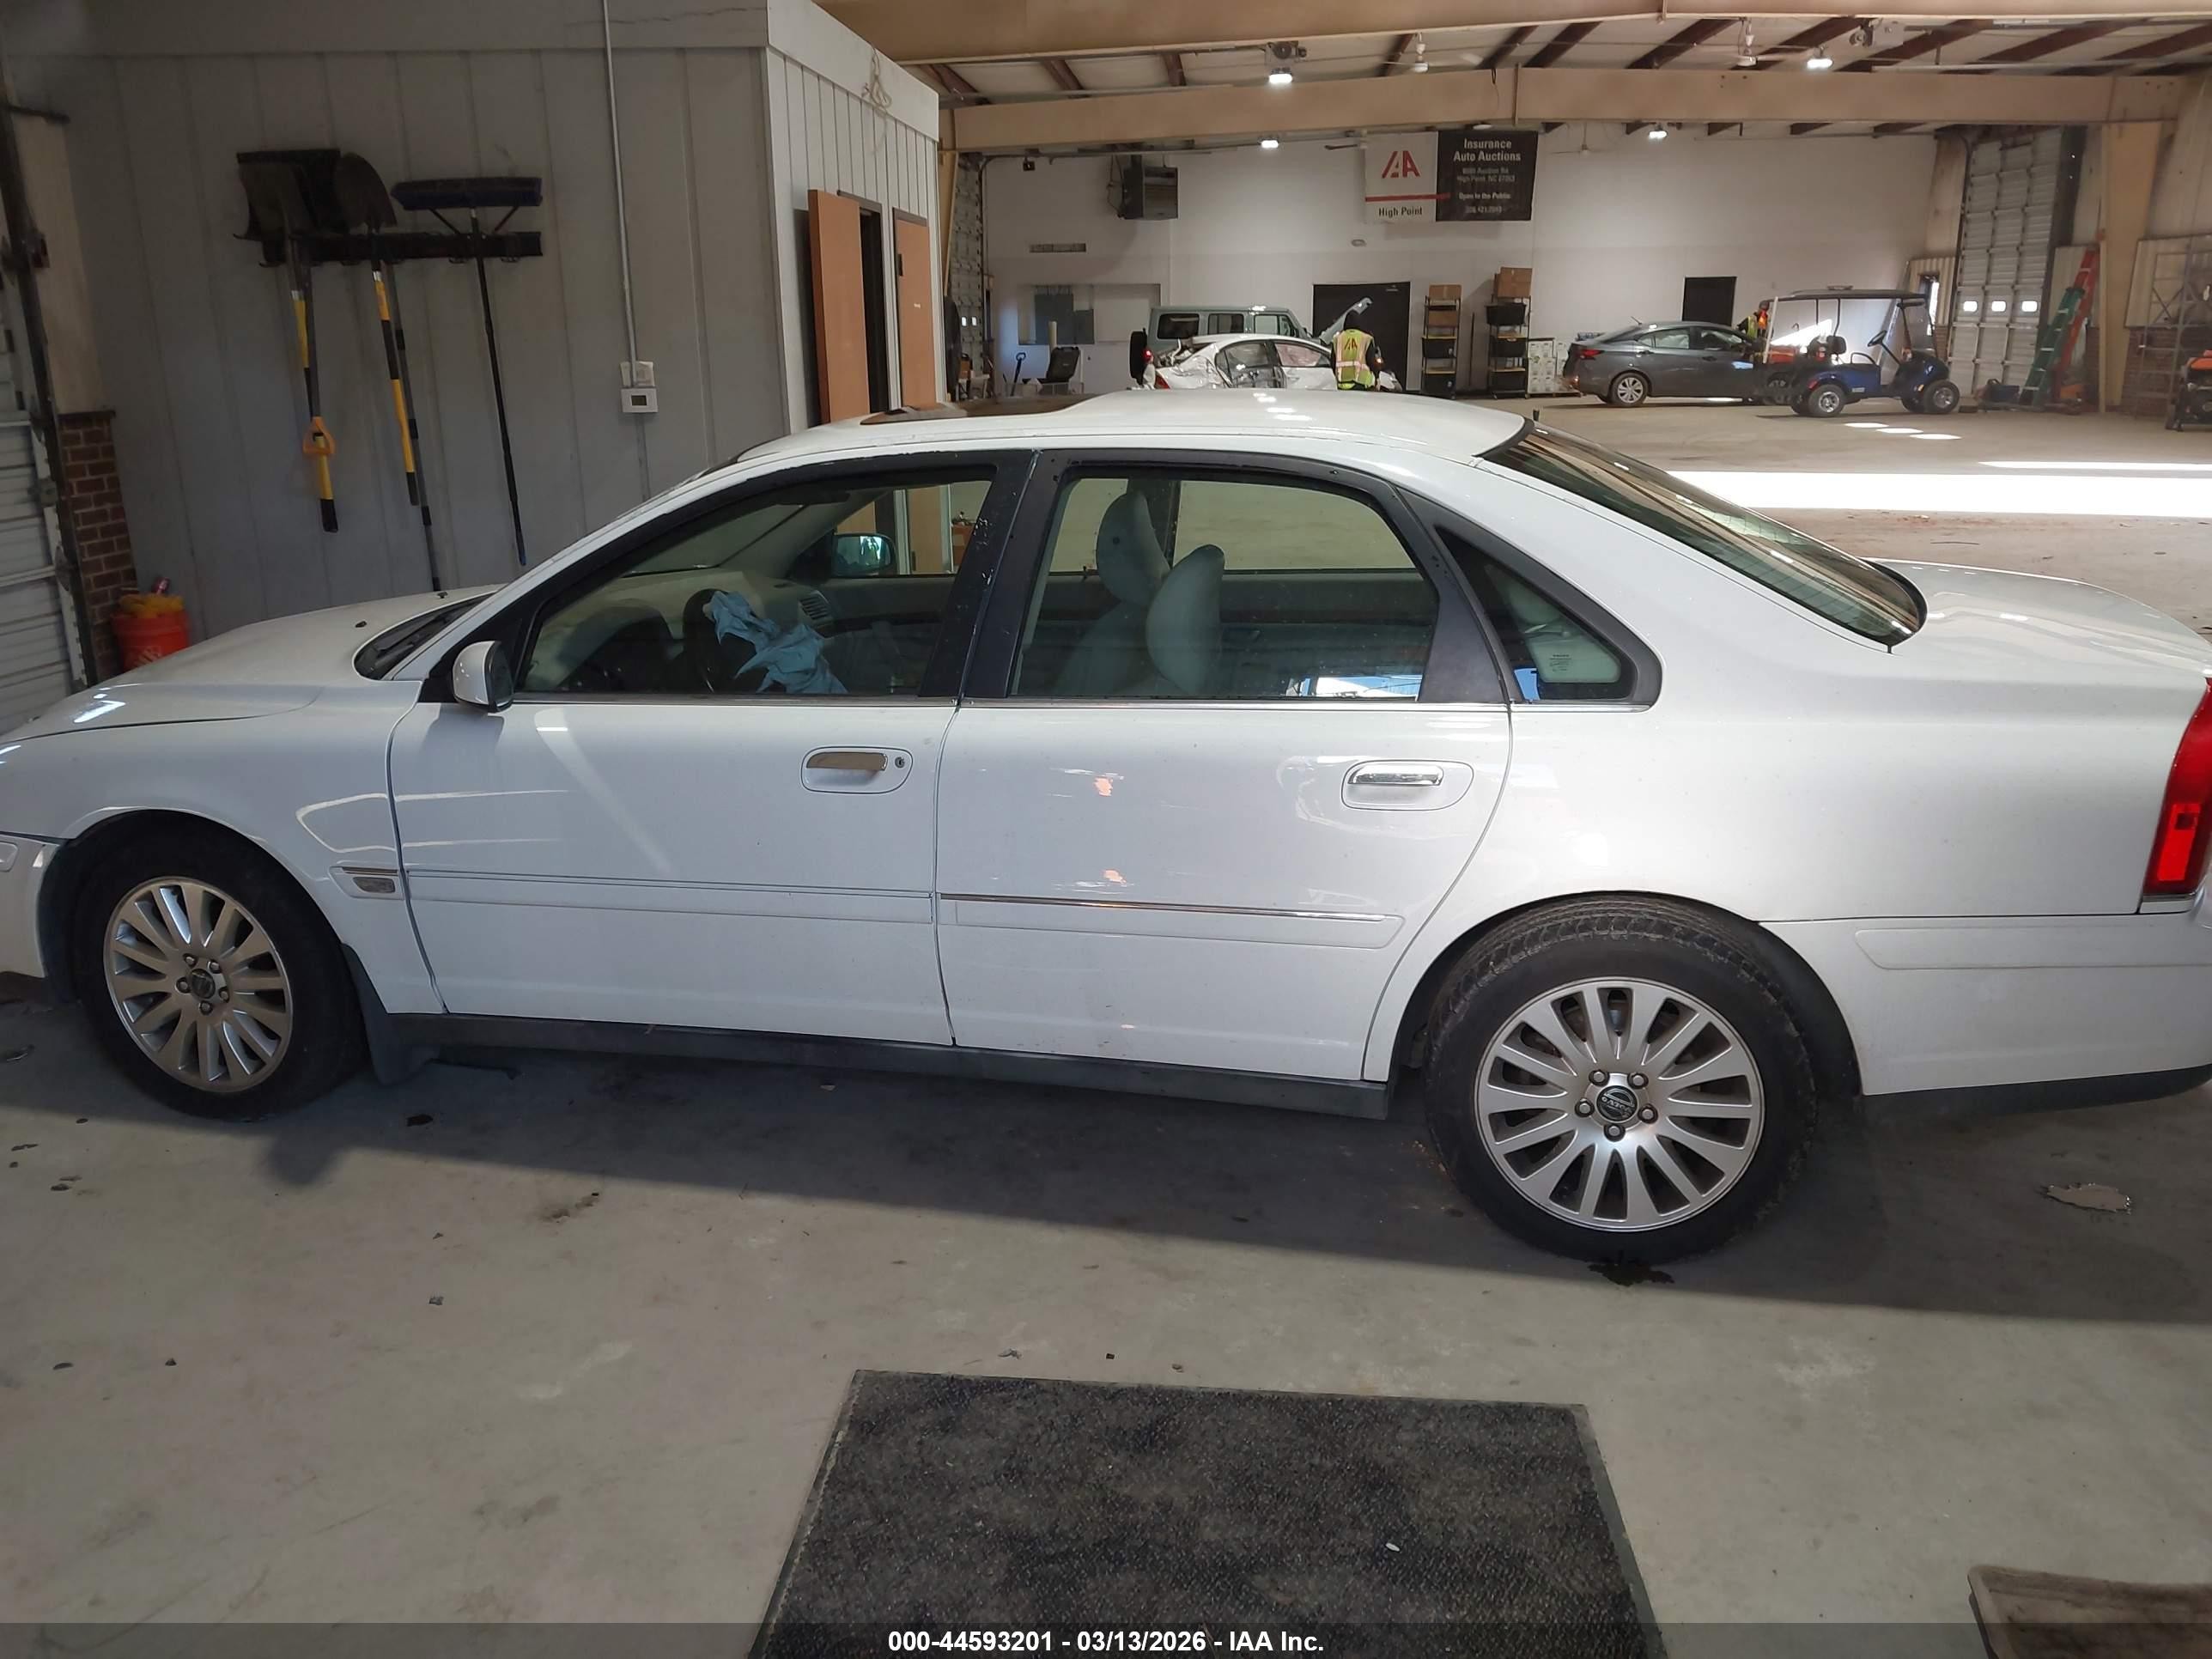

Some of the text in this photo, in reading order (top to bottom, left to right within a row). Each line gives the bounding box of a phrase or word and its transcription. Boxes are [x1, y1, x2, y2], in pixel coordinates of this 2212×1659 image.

[1463, 137, 1512, 149] Insurance
[1453, 149, 1522, 161] Auto Auctions
[1378, 206, 1423, 218] High Point
